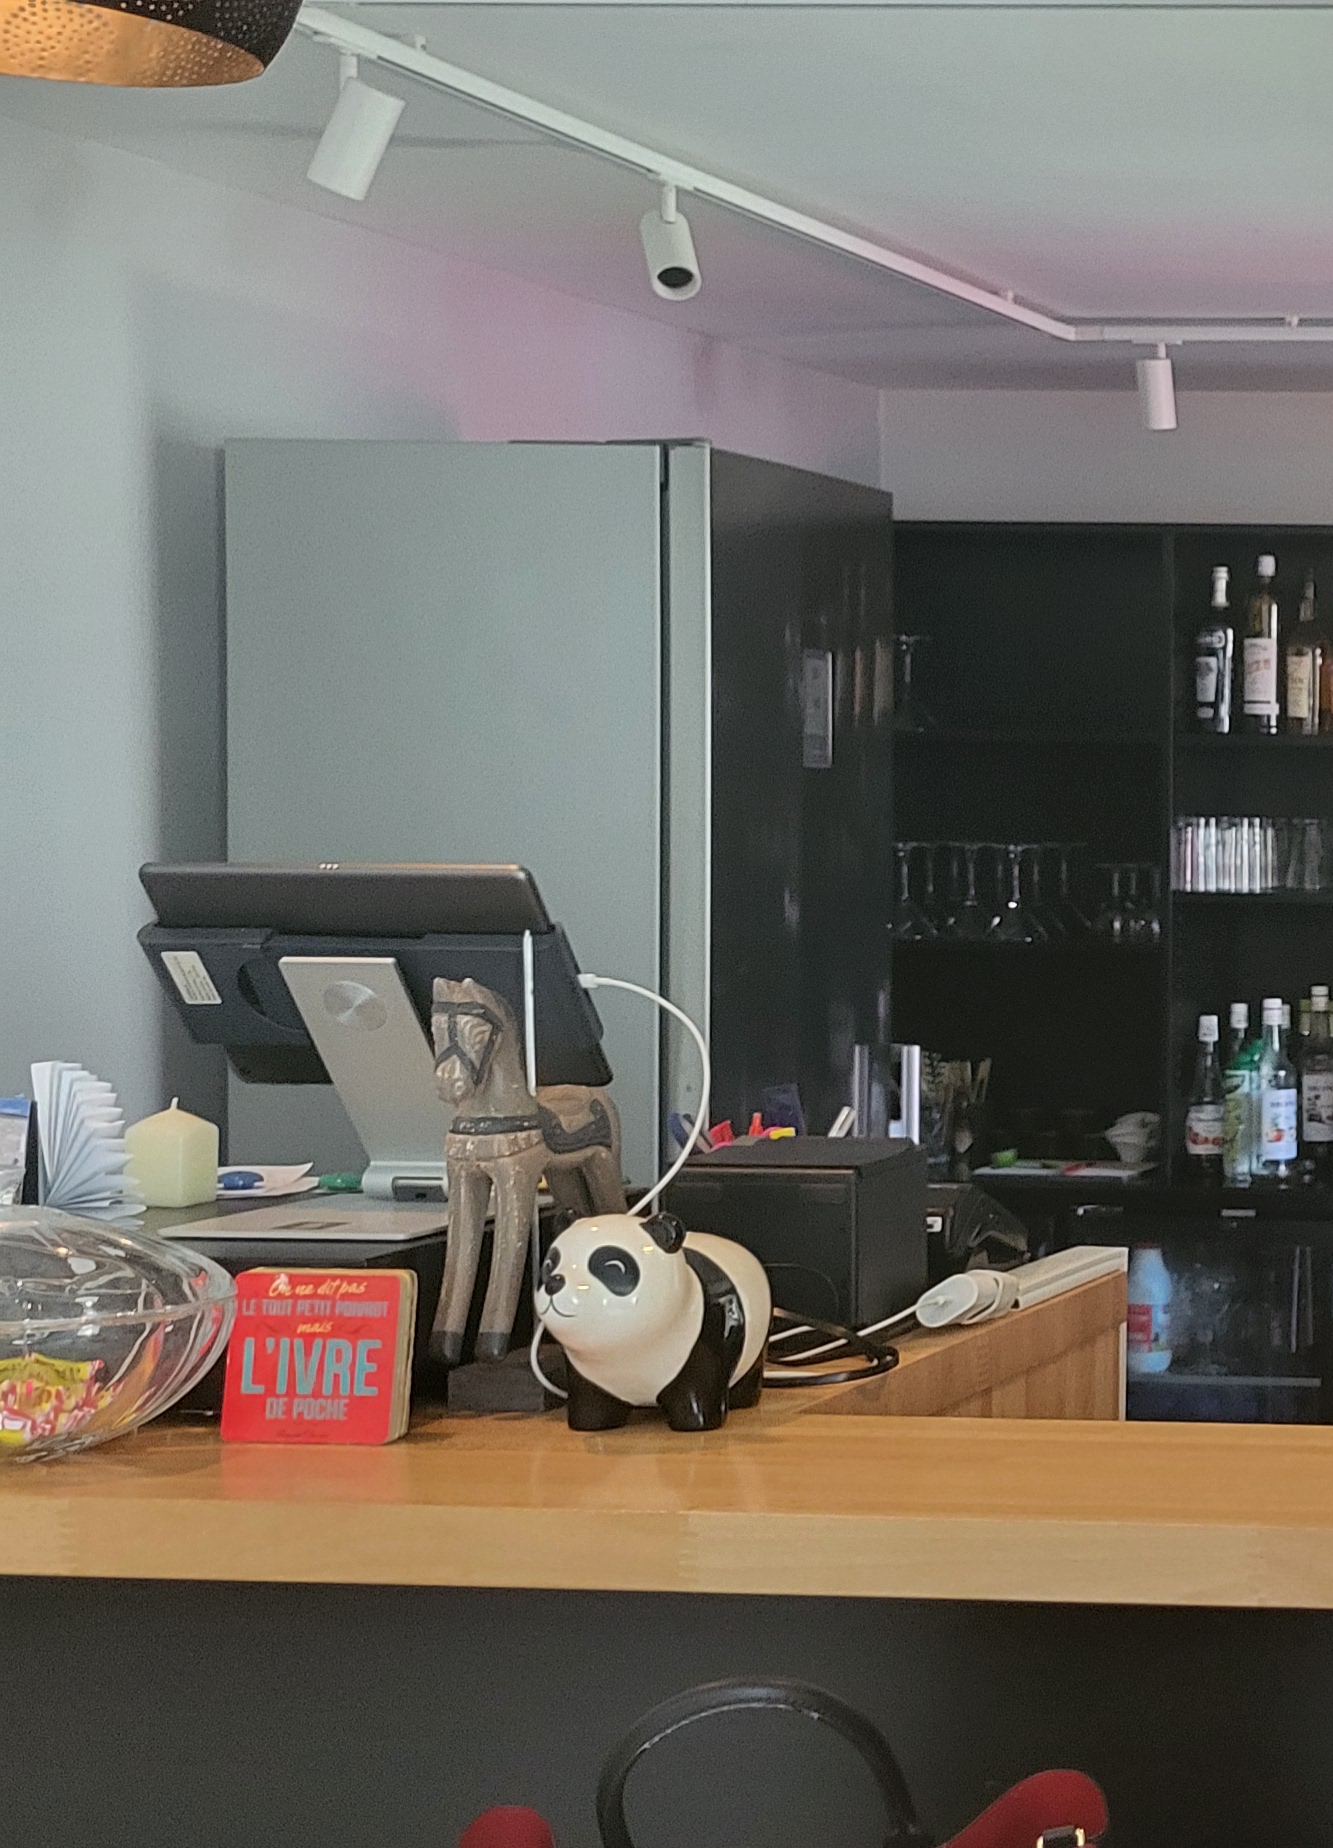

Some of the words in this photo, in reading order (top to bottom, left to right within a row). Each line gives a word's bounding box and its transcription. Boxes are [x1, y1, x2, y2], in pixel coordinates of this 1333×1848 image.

[317, 1278, 338, 1296] dit
[336, 1280, 368, 1300] pas
[242, 1299, 256, 1316] LE
[262, 1299, 293, 1316] TOUT
[297, 1320, 334, 1334] mais
[240, 1336, 382, 1396] L'IVRE
[265, 1398, 286, 1420] DE
[292, 1396, 350, 1421] POCHE
